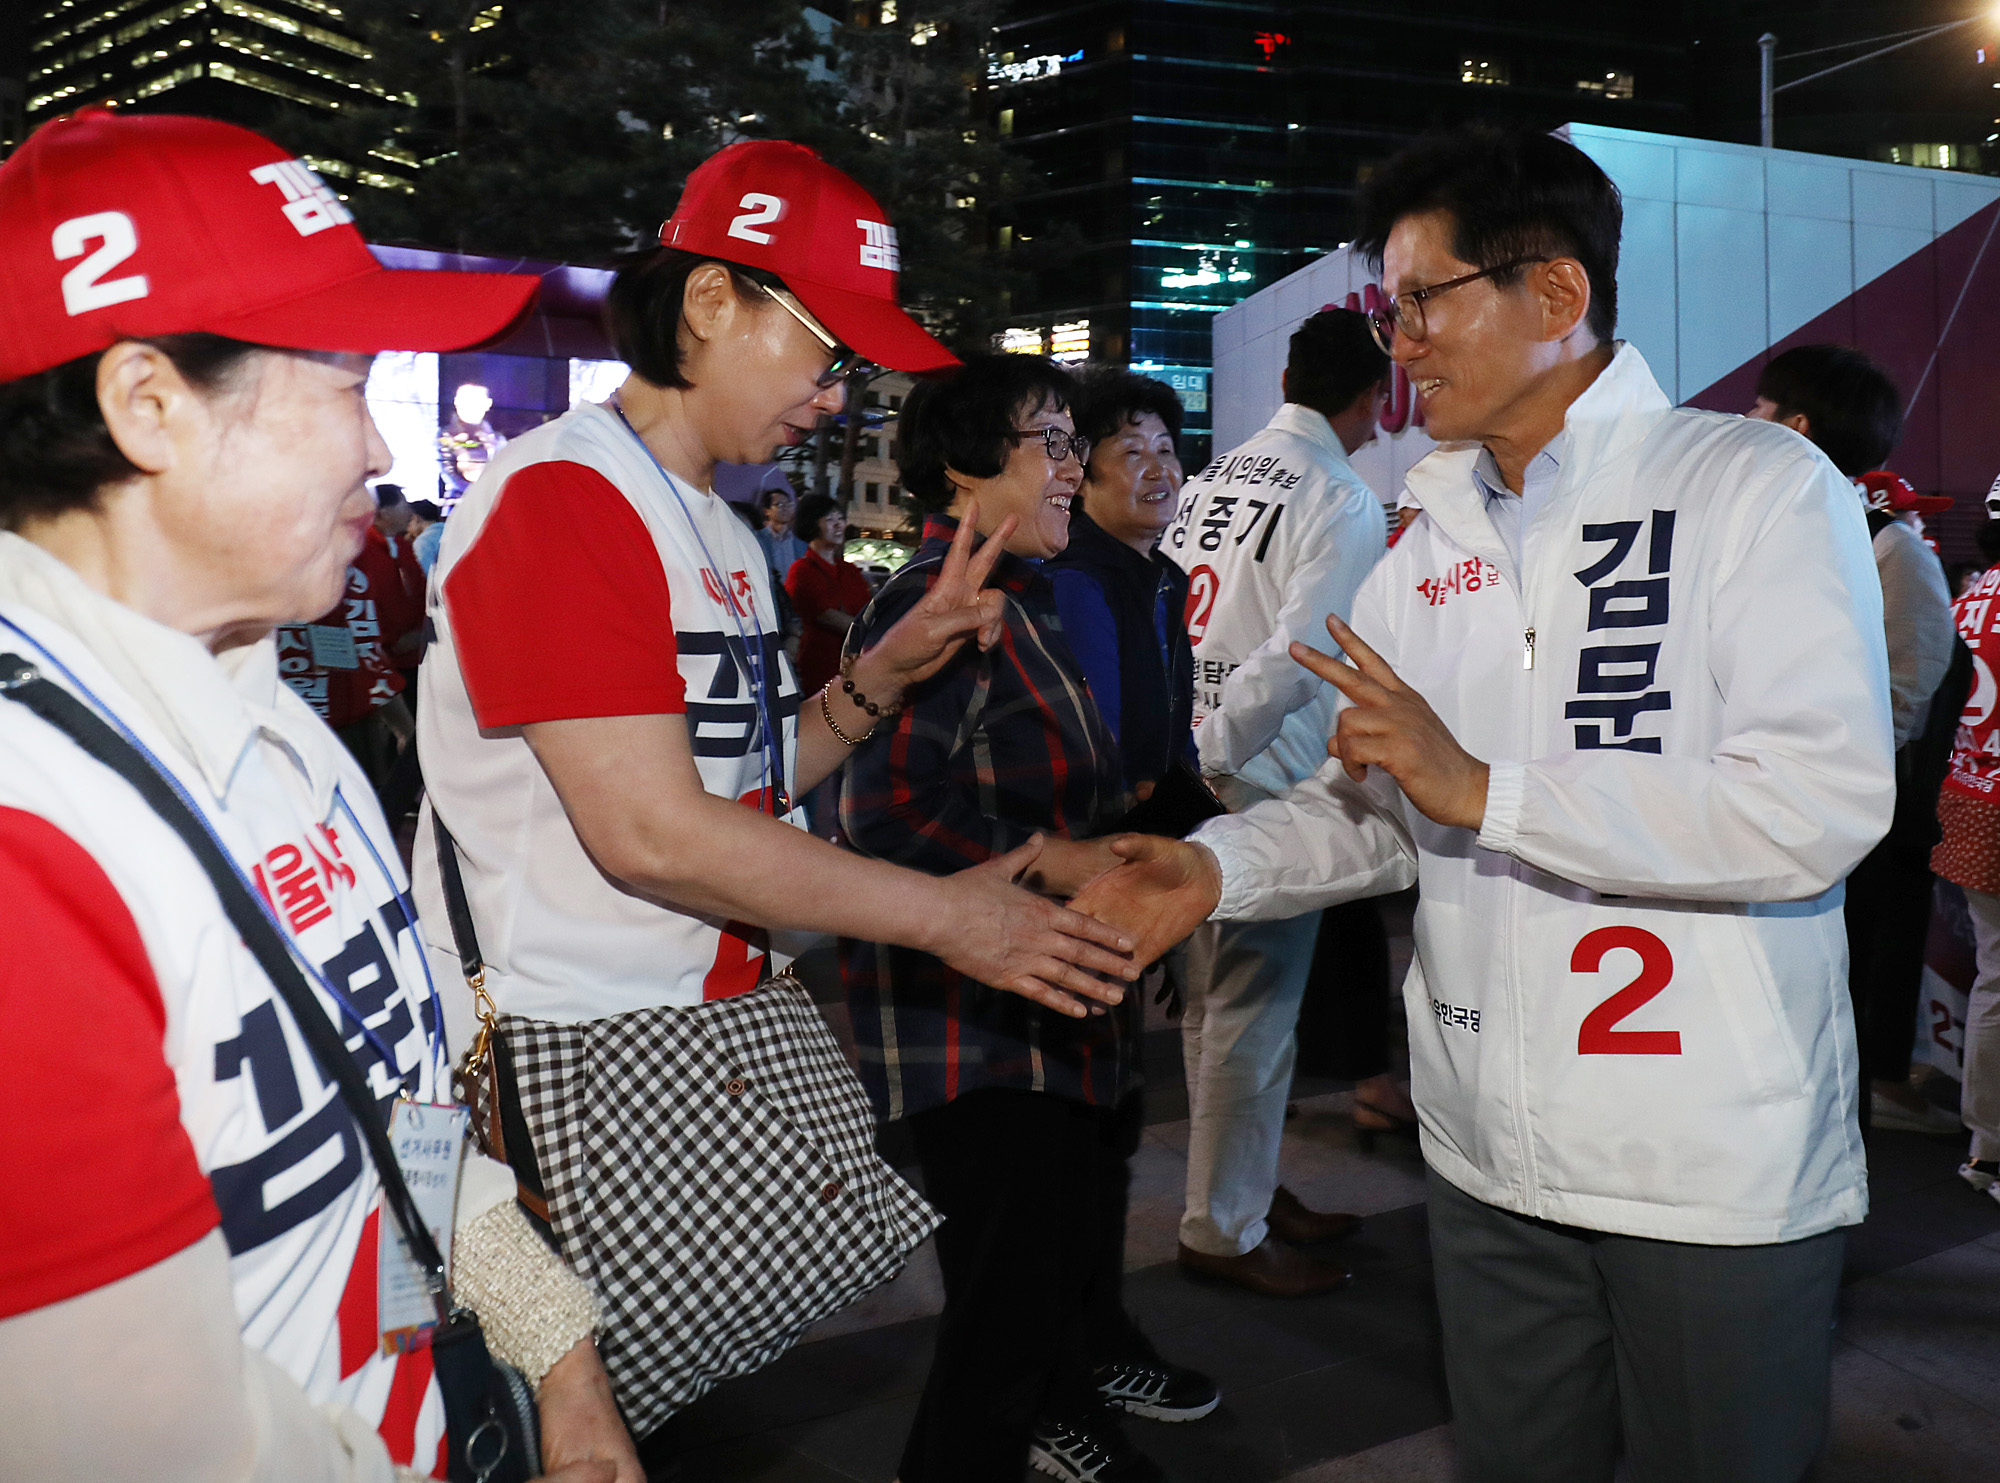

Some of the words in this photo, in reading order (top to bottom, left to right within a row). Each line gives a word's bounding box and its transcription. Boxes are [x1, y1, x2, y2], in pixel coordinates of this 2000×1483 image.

[726, 192, 783, 245] 2
[51, 210, 149, 317] 2
[1171, 374, 1204, 390] 임대
[1872, 489, 1892, 508] 2
[1188, 572, 1212, 638] 2
[1569, 925, 1683, 1055] 2
